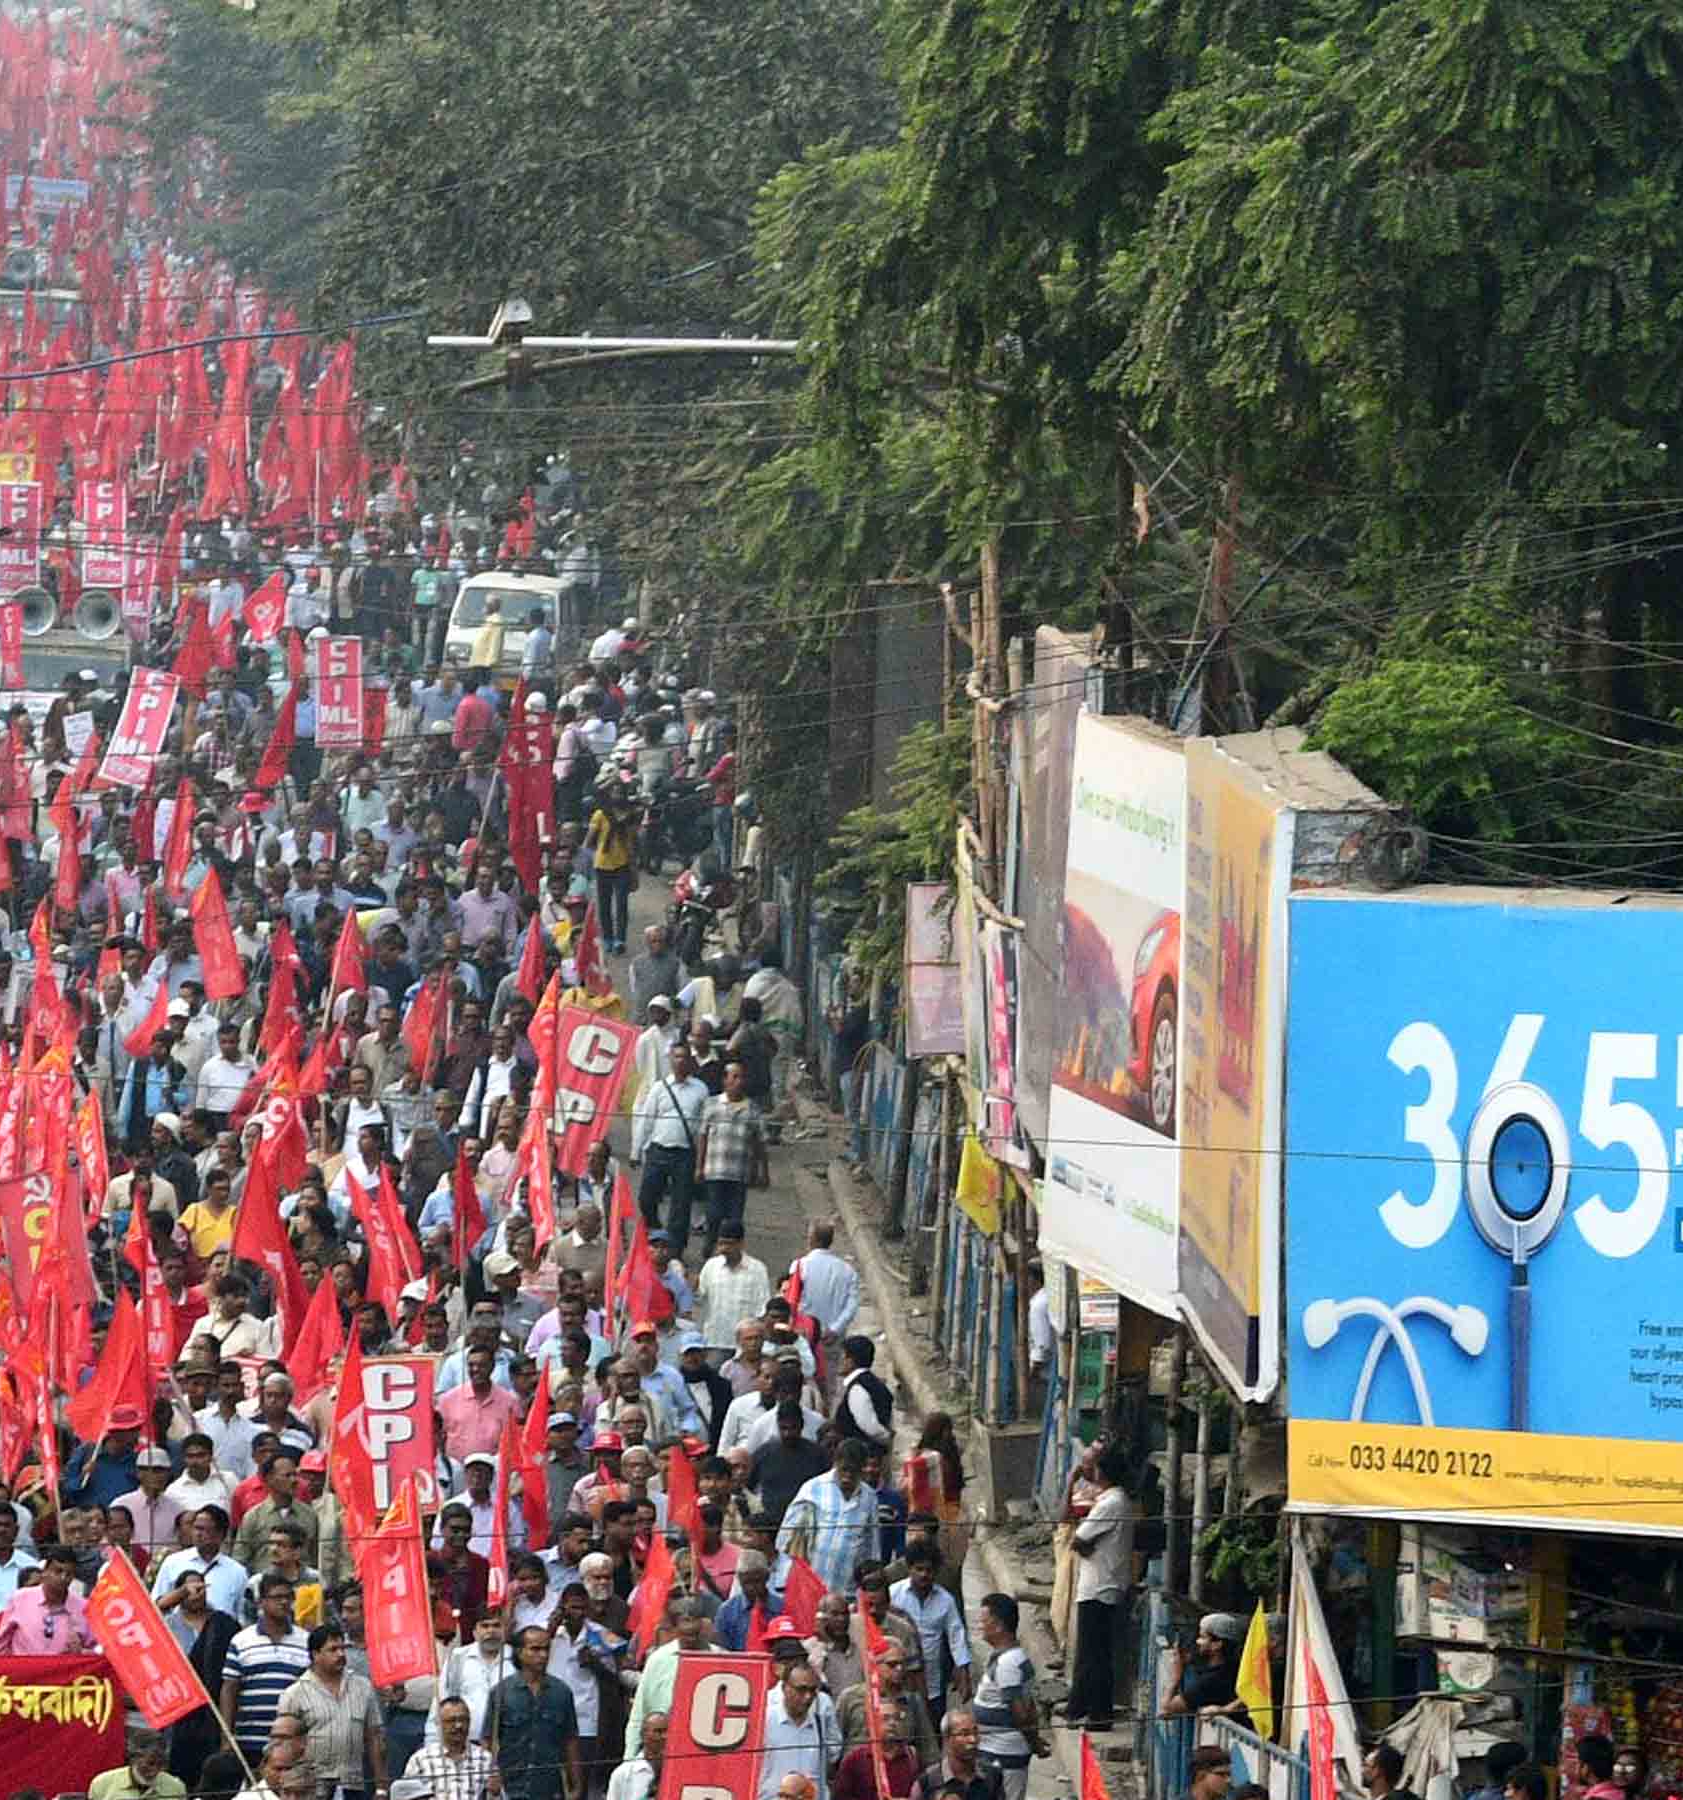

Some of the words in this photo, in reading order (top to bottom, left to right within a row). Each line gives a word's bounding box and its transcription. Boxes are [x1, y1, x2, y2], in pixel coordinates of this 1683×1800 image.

[1378, 1013, 1669, 1258] 365
[1637, 1319, 1663, 1338] Free
[1349, 1445, 1386, 1472] 033
[1391, 1446, 1439, 1475] 4420
[1446, 1450, 1494, 1480] 2122
